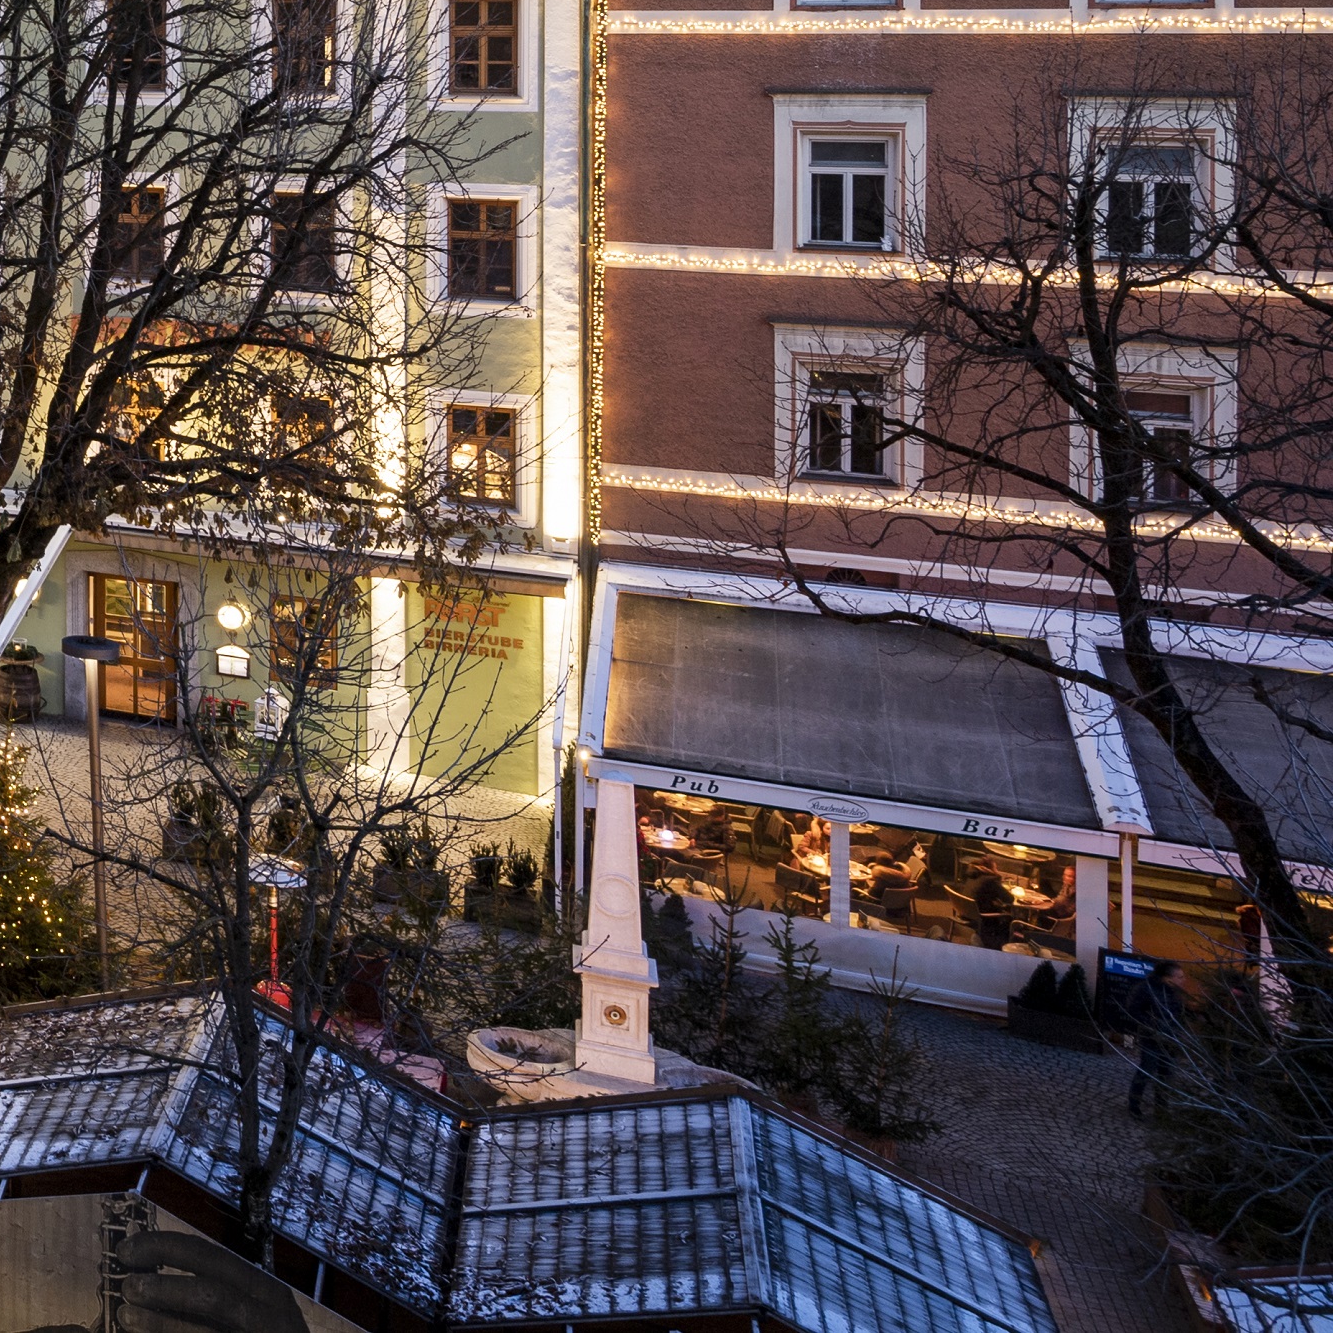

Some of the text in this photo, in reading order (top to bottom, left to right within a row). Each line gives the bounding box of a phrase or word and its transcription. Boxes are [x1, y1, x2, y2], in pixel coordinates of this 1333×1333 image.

[424, 597, 506, 627] FORST
[424, 628, 524, 649] BIERSTUBE
[670, 775, 719, 794] Pub
[961, 818, 1015, 838] Bar
